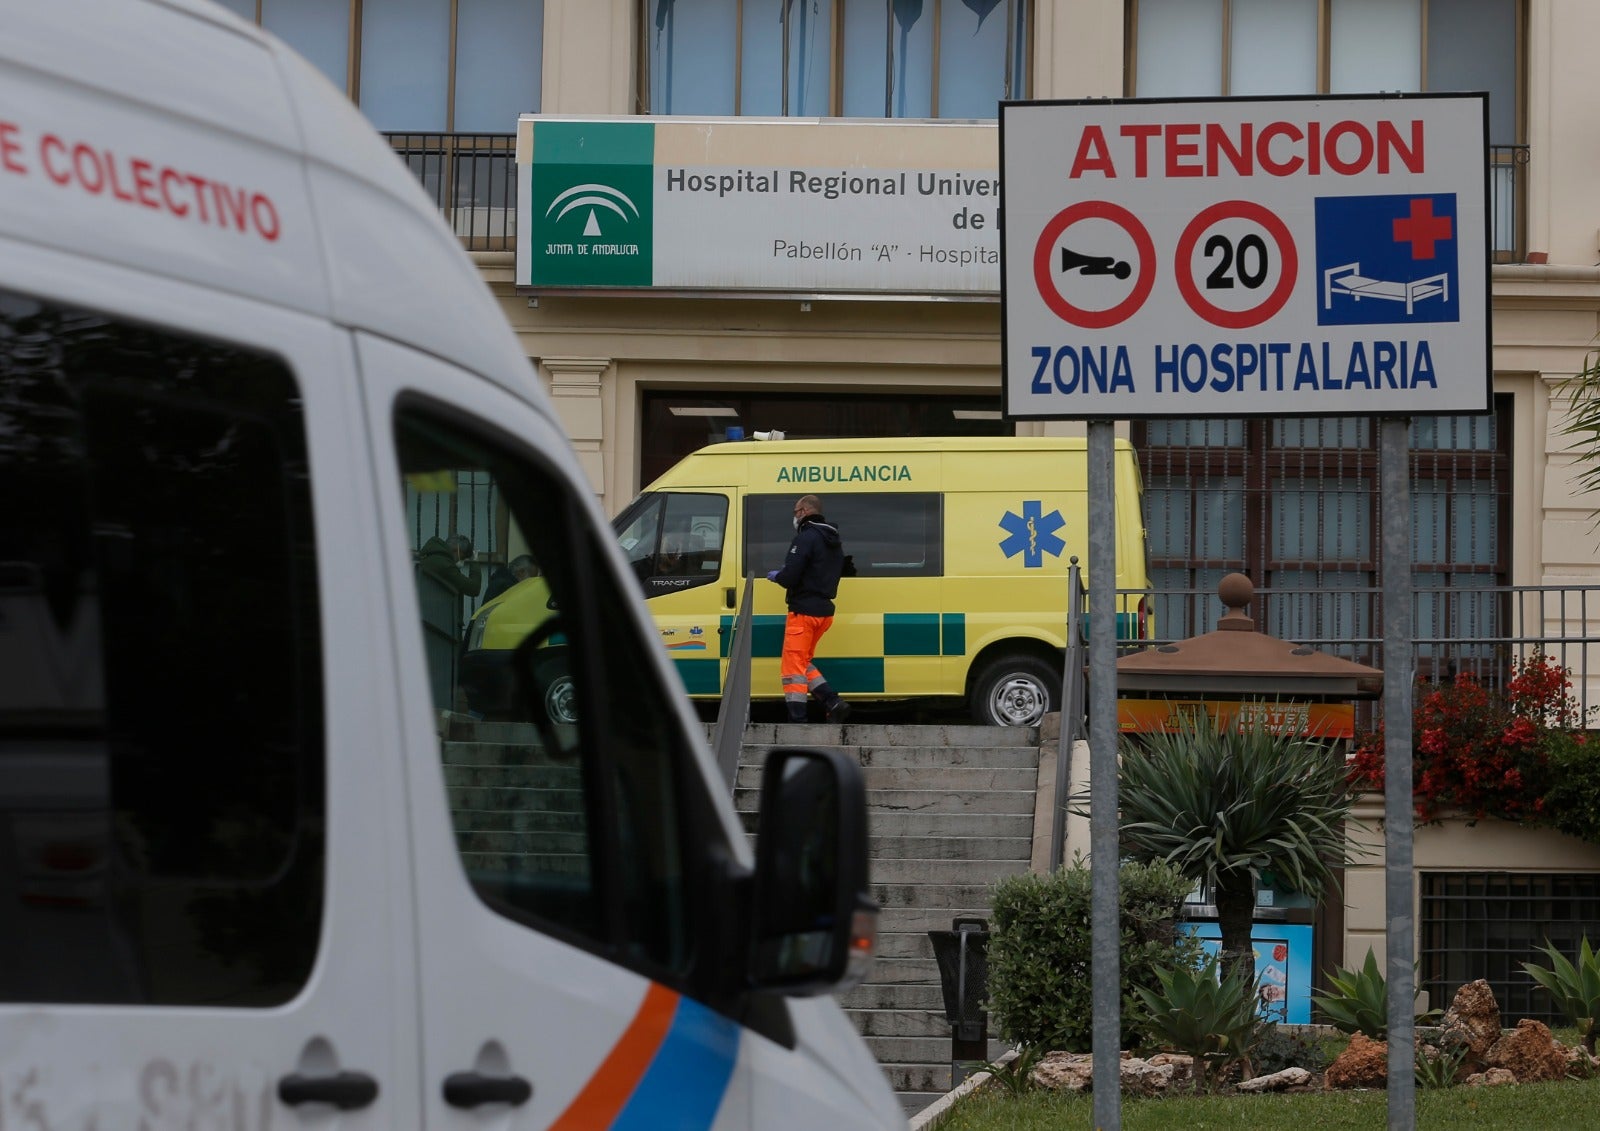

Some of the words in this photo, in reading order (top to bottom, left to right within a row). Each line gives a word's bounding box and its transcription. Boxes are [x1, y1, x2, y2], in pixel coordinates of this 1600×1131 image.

[1069, 120, 1424, 179] ATENCION
[40, 134, 281, 242] COLECTIVO
[667, 169, 778, 197] Hospital
[789, 171, 905, 199] Regional
[952, 207, 985, 230] de
[545, 244, 574, 255] JUNTA
[577, 244, 588, 255] DE
[773, 239, 862, 261] Pabellón
[1204, 234, 1268, 289] 20
[1031, 345, 1136, 394] ZONA
[1155, 340, 1438, 393] HOSPITALARIA
[776, 465, 912, 483] AMBULANCIA
